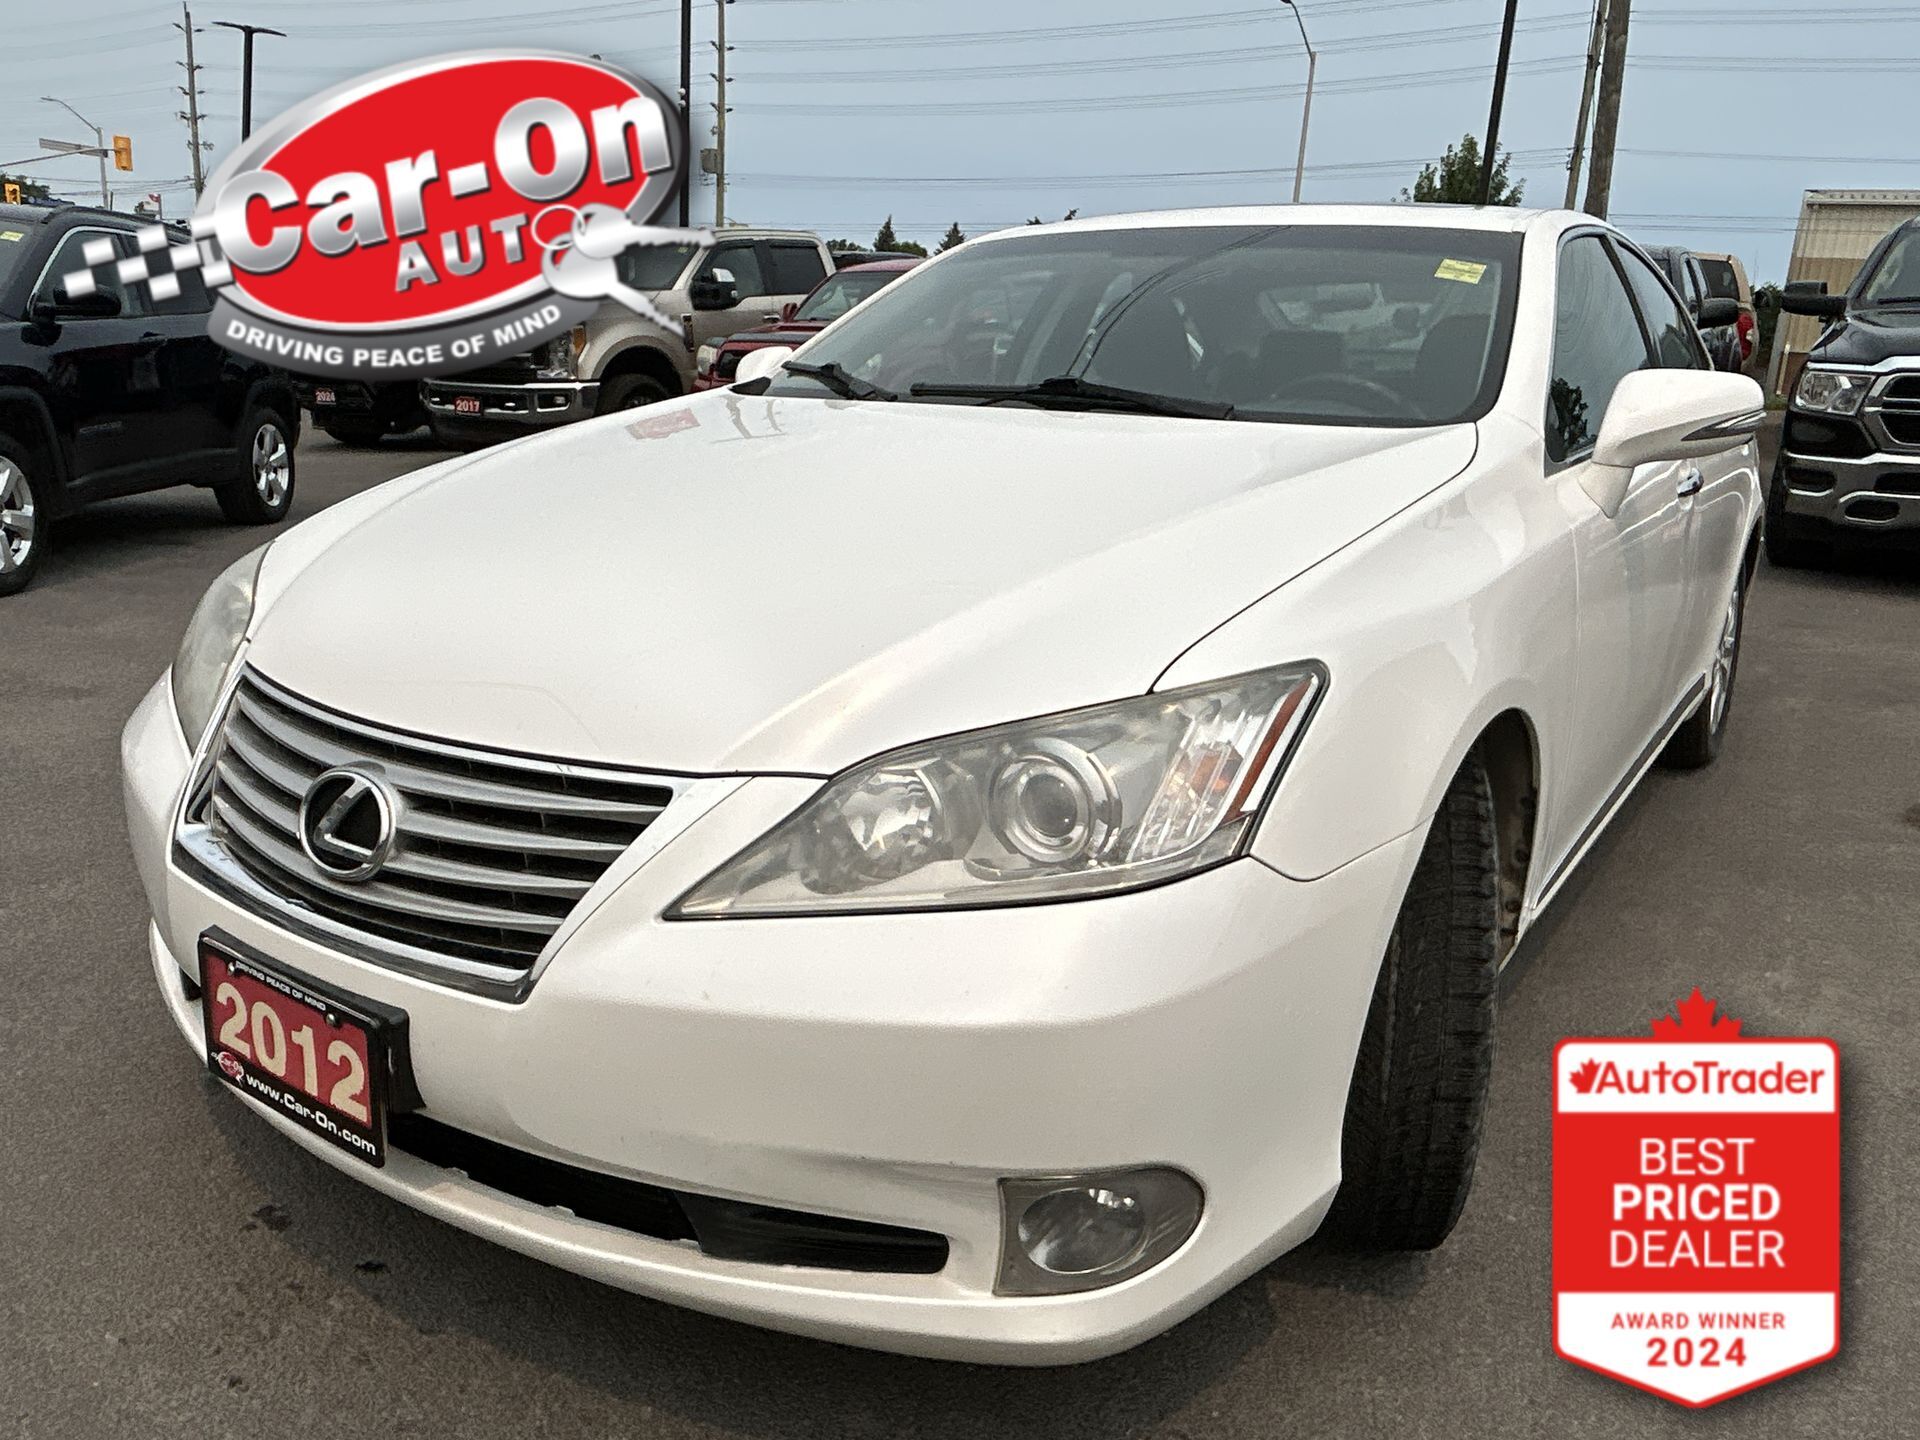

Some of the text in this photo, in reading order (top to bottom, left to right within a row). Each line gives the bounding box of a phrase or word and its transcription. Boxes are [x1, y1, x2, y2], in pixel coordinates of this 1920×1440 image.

[455, 400, 480, 412] 2017
[216, 982, 368, 1123] 2012
[246, 1074, 376, 1156] www.Car-On.com
